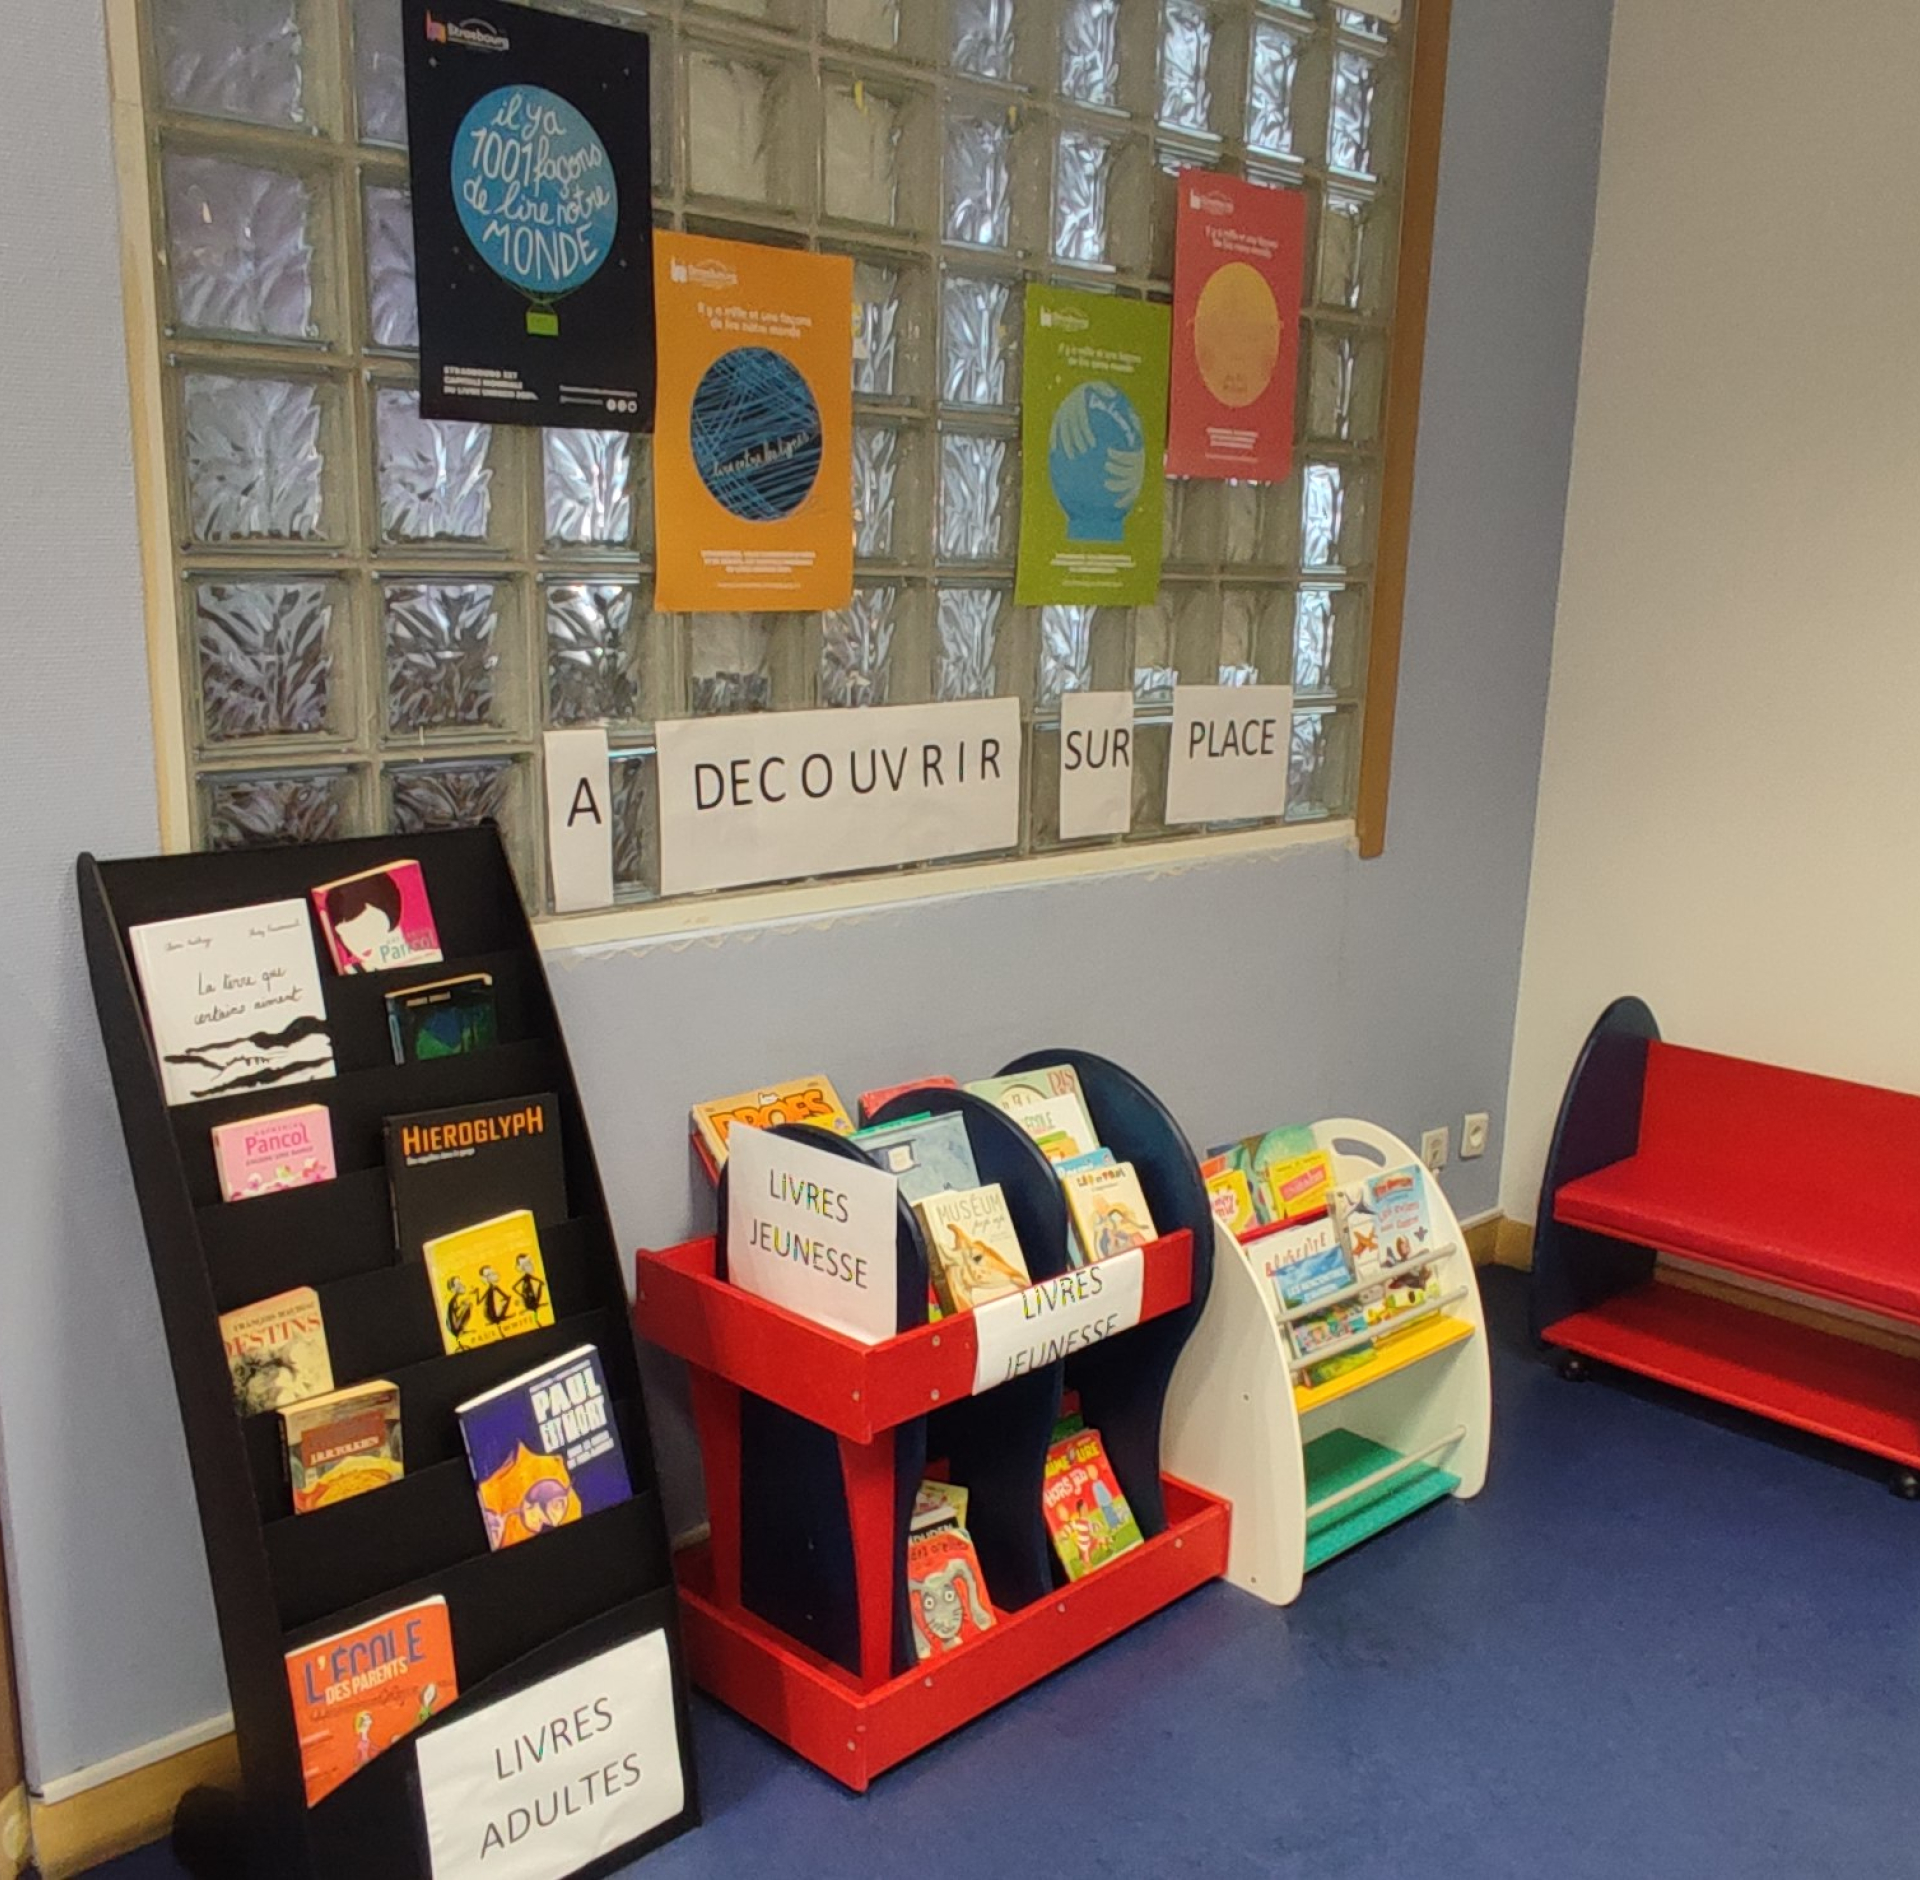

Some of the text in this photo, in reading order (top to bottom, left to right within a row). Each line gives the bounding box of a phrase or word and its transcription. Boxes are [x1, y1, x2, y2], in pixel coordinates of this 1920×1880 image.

[471, 127, 602, 198] 1001 façons
[463, 174, 610, 226] de lire notre
[482, 219, 598, 281] MONDE
[1064, 729, 1130, 770] SUR
[1189, 719, 1277, 759] PLACE
[567, 777, 602, 827] A
[695, 739, 1000, 810] DECOUVRIR
[199, 971, 216, 996] La
[223, 973, 257, 990] terre
[245, 1122, 309, 1156] Pancol
[402, 1105, 544, 1156] HIEROGLYPH
[770, 1168, 849, 1224] LIVRES
[749, 1218, 868, 1290] JEUNESSE
[1022, 1266, 1103, 1320] LIVRES
[1005, 1313, 1118, 1381] JEUNESSE
[530, 1366, 602, 1424] PAUL
[325, 1679, 351, 1705] DES
[351, 1656, 409, 1695] PARENTS
[495, 1697, 613, 1781] LIVRES
[480, 1753, 641, 1860] ADULTES
